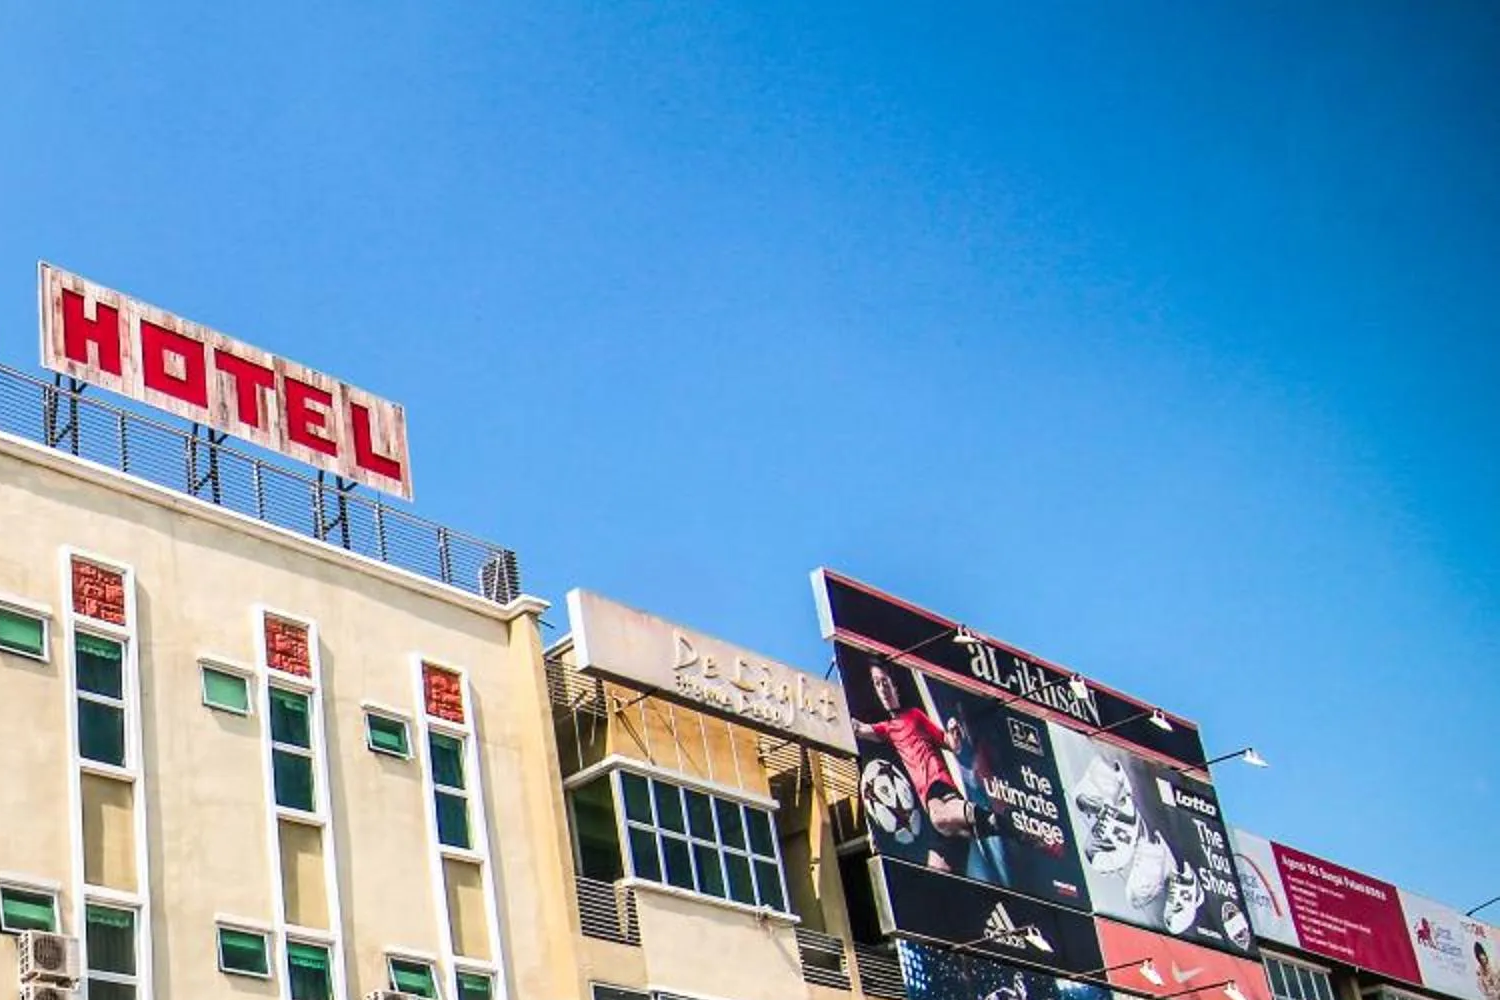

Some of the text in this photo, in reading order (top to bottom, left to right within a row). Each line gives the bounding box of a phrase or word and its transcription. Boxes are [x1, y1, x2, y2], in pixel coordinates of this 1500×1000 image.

[61, 287, 402, 482] HOTEL
[1020, 765, 1053, 795] the
[983, 775, 1059, 820] ultimate
[1011, 808, 1065, 846] stage
[1192, 817, 1224, 850] The
[1201, 843, 1232, 875] You
[1200, 867, 1240, 900] Shoe
